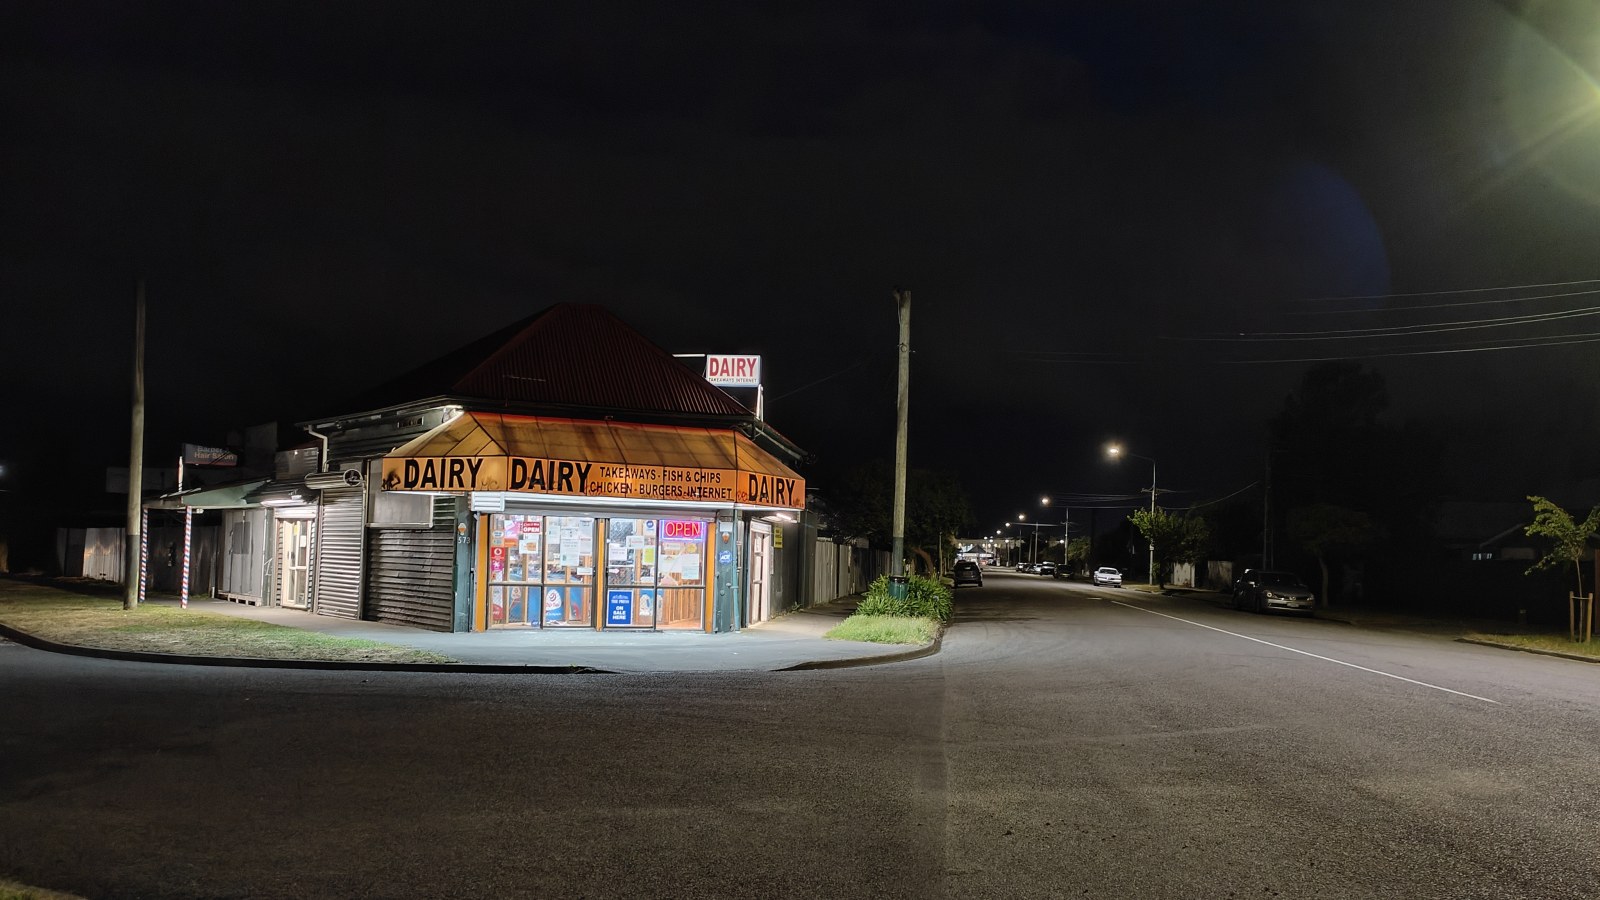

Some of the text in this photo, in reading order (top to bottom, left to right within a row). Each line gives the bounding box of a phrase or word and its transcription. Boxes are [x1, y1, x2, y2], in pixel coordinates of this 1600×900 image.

[710, 358, 757, 376] DAIRY
[404, 458, 484, 488] DAIRY
[510, 458, 592, 493] DAIRY
[600, 466, 656, 480] TAKEAWAYS
[663, 470, 683, 482] FISH
[686, 471, 691, 482] &
[694, 472, 720, 483] CHIPS
[590, 481, 632, 494] CHICKEN
[640, 484, 682, 496] BURGERS
[687, 487, 732, 499] INTERNET
[749, 474, 795, 505] DAIRY
[666, 522, 700, 537] OPEN
